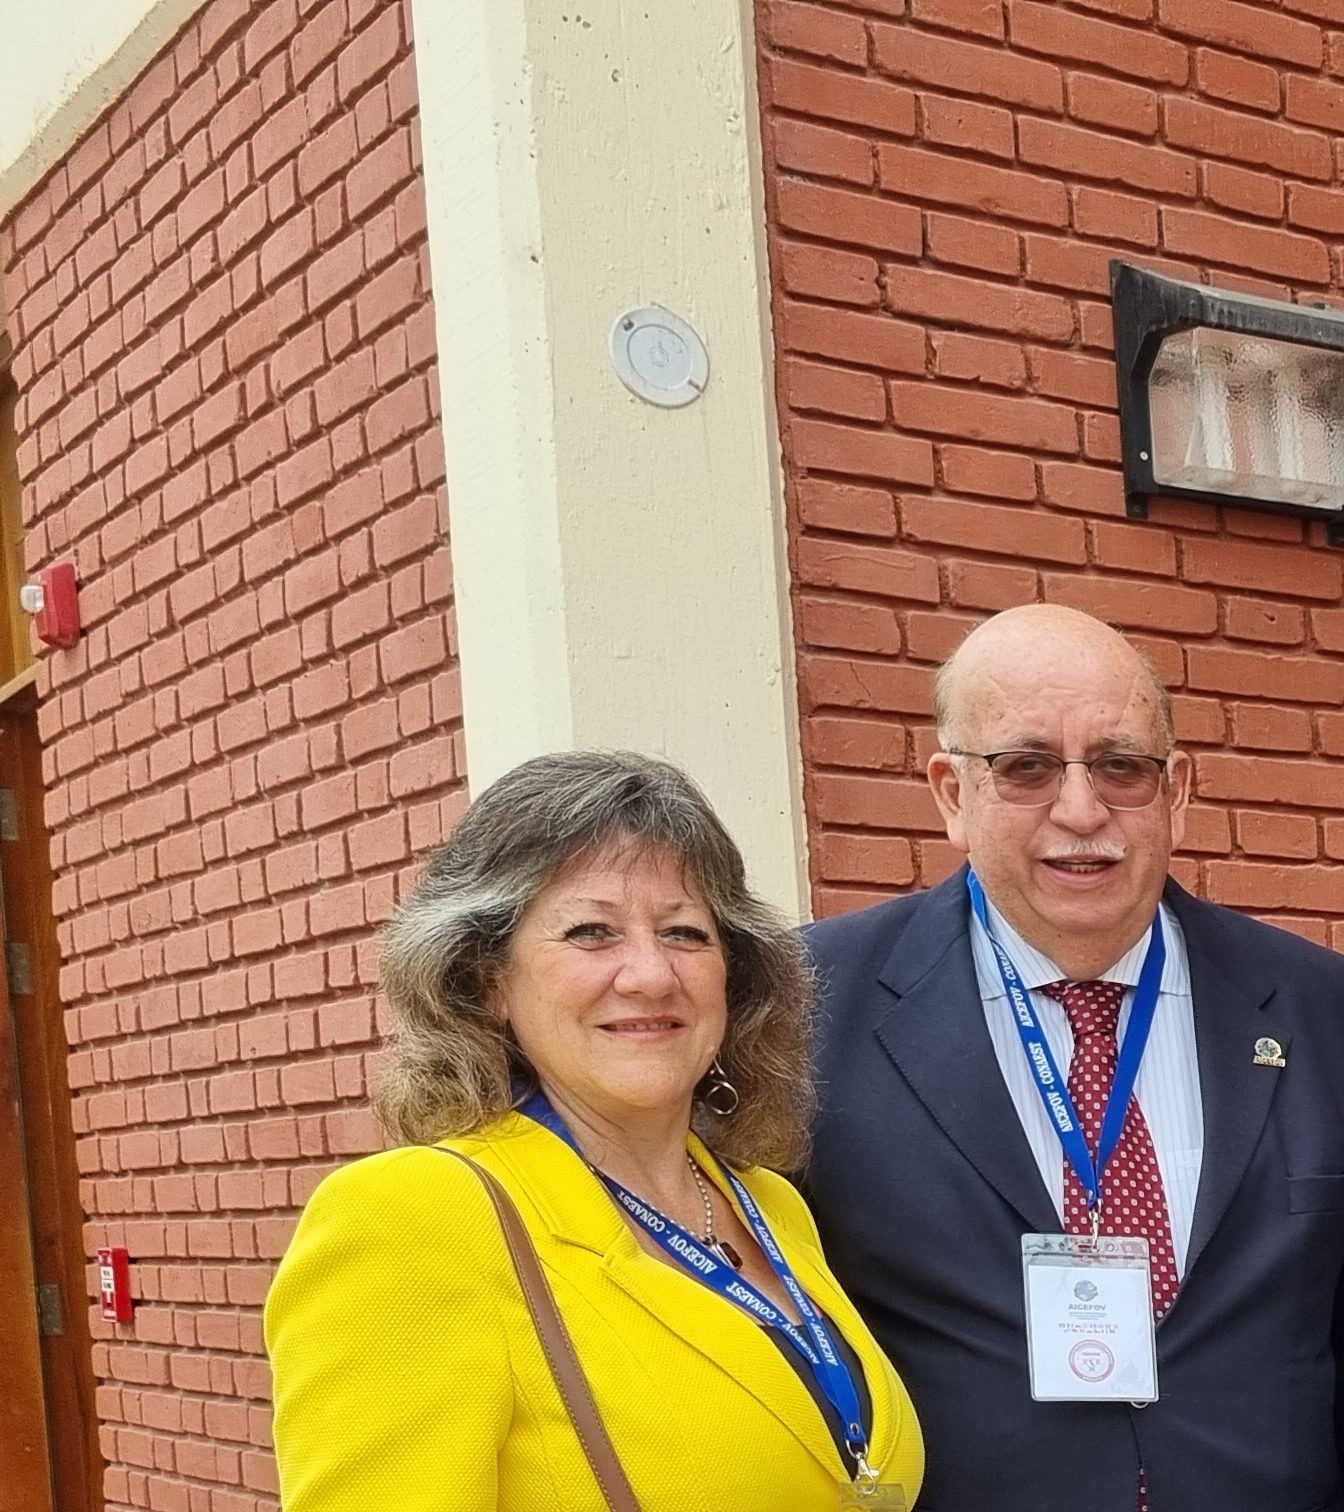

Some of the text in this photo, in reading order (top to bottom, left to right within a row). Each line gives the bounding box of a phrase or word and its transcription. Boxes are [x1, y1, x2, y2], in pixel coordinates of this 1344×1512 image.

[1028, 1041, 1055, 1085] CONAEST
[616, 1189, 718, 1275] AICEFOV CONAEST
[725, 1281, 777, 1324] CONAEST
[814, 1320, 839, 1368] AICEFOV
